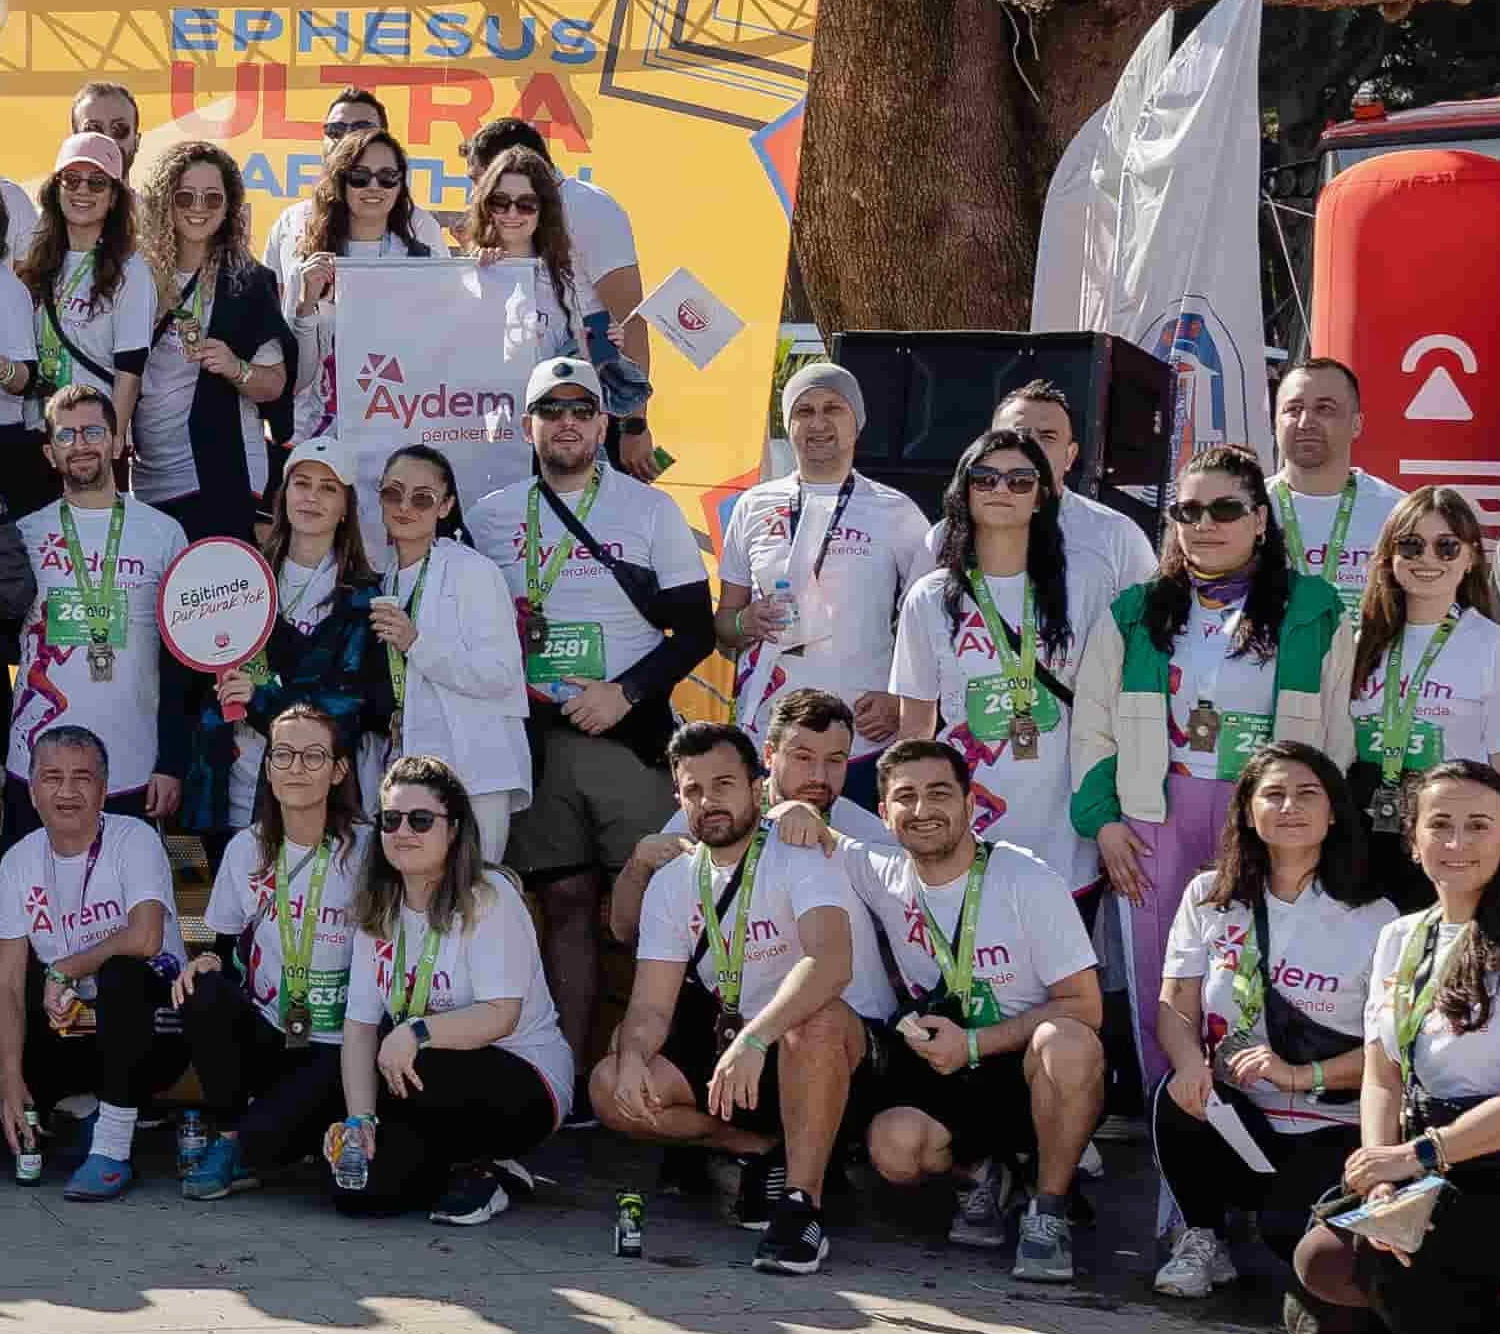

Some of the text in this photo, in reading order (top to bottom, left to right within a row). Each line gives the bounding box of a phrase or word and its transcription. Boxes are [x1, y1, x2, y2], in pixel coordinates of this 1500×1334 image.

[170, 8, 598, 64] EPHESUS
[168, 61, 595, 154] ULTRA
[365, 383, 515, 428] Aydem
[181, 578, 249, 607] Eğitimde
[199, 597, 239, 619] Durak
[541, 638, 590, 660] 2581
